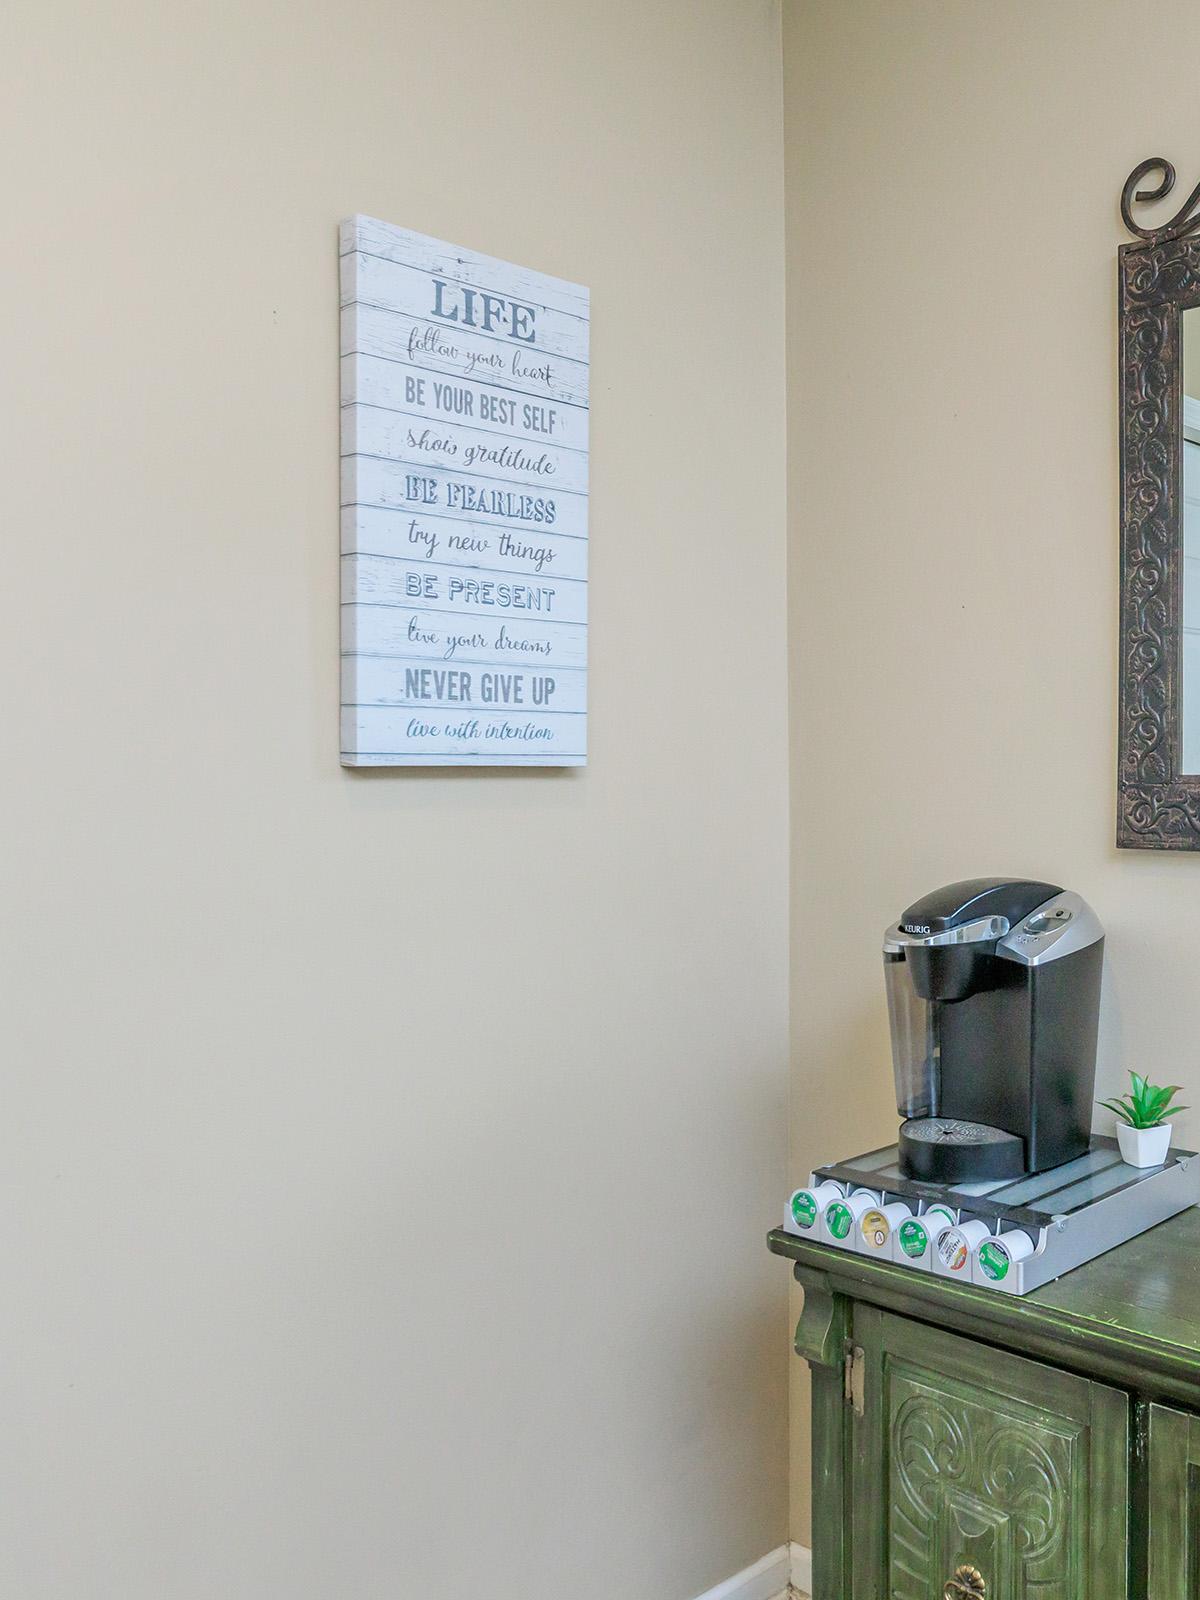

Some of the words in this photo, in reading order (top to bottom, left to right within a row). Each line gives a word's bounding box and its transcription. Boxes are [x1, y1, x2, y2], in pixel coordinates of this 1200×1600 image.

[431, 279, 536, 343] LIFE
[407, 327, 459, 360] follow
[464, 350, 505, 374] your
[512, 351, 557, 388] heart
[405, 376, 425, 407] BE
[433, 382, 473, 416] YOUR
[480, 394, 517, 426] BEST
[523, 404, 556, 434] SELF
[407, 429, 458, 455] show
[465, 443, 556, 475] gratitude
[405, 475, 438, 504] BE
[447, 482, 557, 524] FEARLESS
[408, 519, 440, 559] try
[448, 534, 491, 552] new
[499, 533, 557, 572] things
[406, 572, 438, 599] BE
[449, 577, 556, 612] PRESENT
[407, 615, 439, 643] live
[446, 634, 488, 660] your
[494, 626, 553, 656] dreams
[405, 668, 471, 701] NEVER
[481, 673, 523, 704] GIVE
[532, 677, 555, 705] UP
[406, 718, 441, 738] live
[445, 719, 481, 740] with
[485, 722, 554, 741] intention
[905, 924, 930, 934] KEURIG
